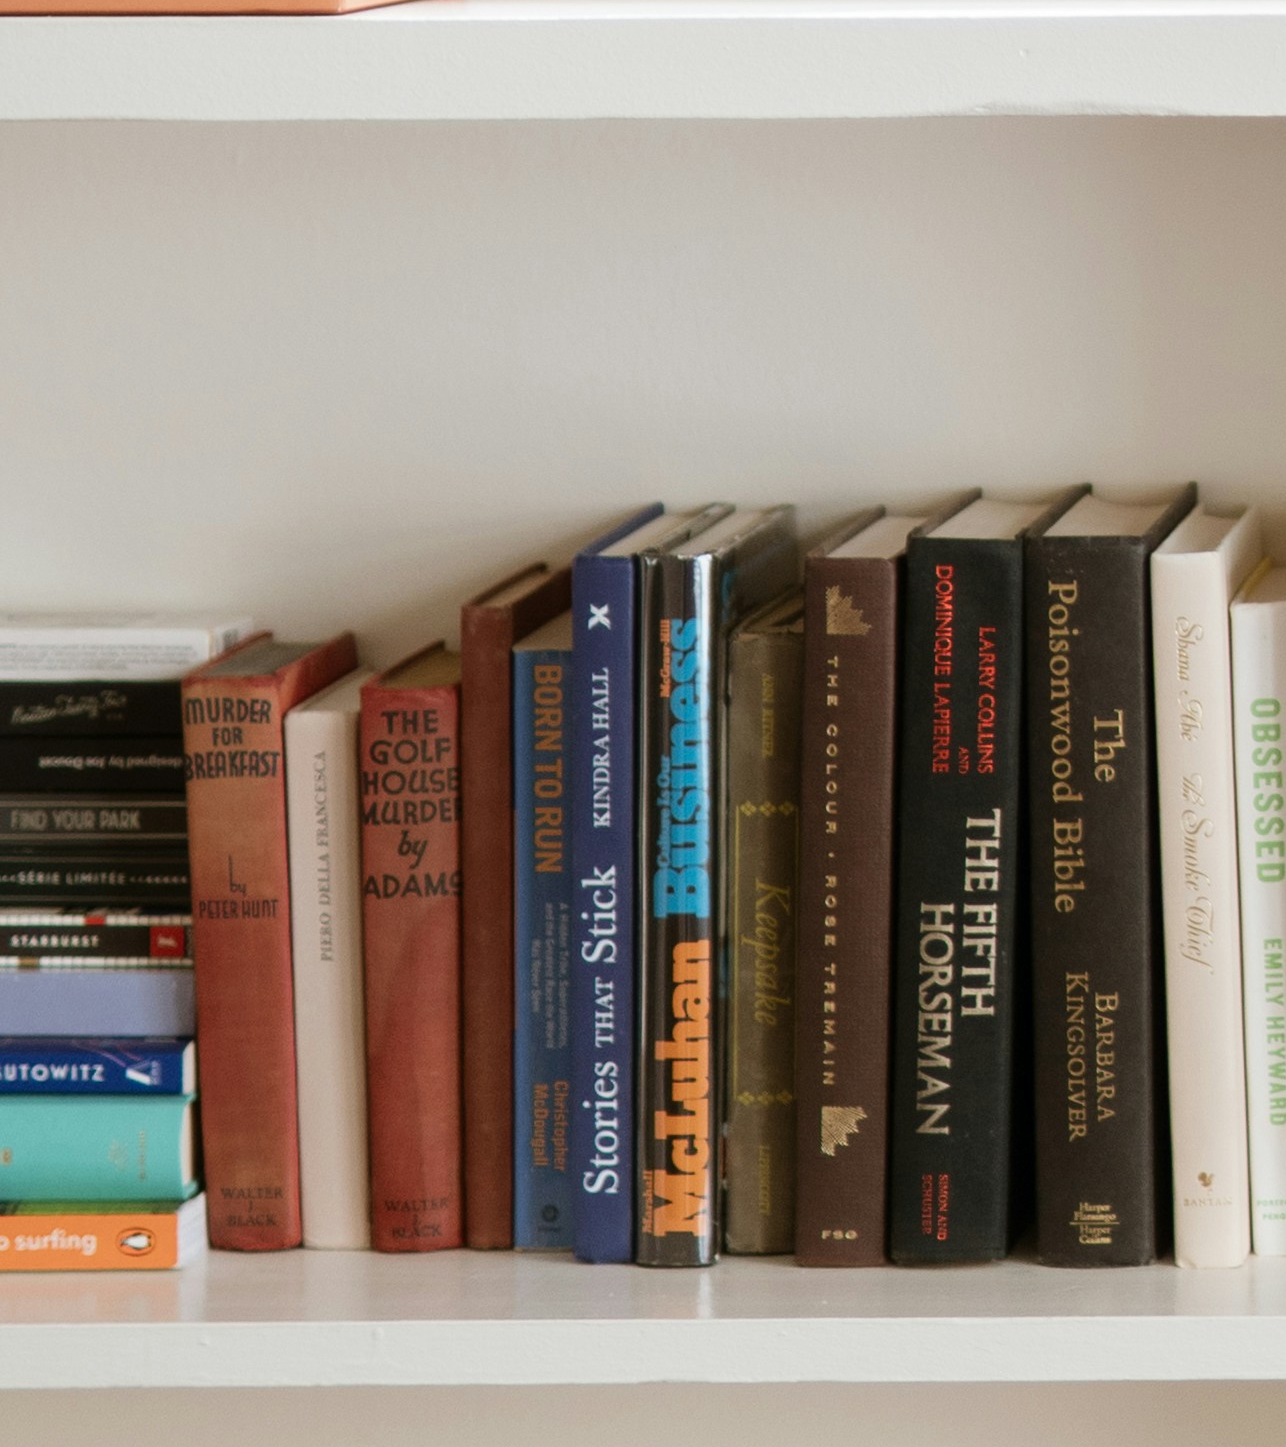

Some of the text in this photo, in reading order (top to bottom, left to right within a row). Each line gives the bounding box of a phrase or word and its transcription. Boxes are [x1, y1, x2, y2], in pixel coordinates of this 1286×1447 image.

[185, 698, 271, 724] MURDER
[534, 665, 562, 751] BORN
[932, 564, 954, 774] DOMINIQUE LAPIERRE
[976, 626, 996, 774] LARRY COLLINS
[213, 727, 243, 746] FOR
[370, 739, 450, 764] GOLF
[381, 710, 438, 734] THE
[592, 667, 610, 828] KINDRA HALL
[958, 746, 970, 775] AND
[1048, 579, 1086, 913] Poisonwood Bible
[1094, 708, 1128, 783] The
[534, 760, 562, 800] TO
[654, 618, 710, 918] Business
[1250, 698, 1286, 883] OBSESSED
[314, 751, 332, 961] PIERO DELLA FRANCESCA
[534, 808, 562, 873] RUN
[822, 656, 839, 1086] THE COLOUR ROSE TREMAIN
[11, 935, 99, 947] STARBURST
[741, 877, 790, 1025] Keepsake
[961, 808, 1001, 1017] THE FIFTH
[1264, 938, 1285, 1007] EMILY
[581, 865, 619, 1195] Stories THAT Stick
[916, 901, 955, 1136] HORSEMAN
[1065, 971, 1090, 1143] KINGSOLVER
[1095, 991, 1119, 1122] BARBARA
[533, 1083, 548, 1167] McDougall
[553, 1080, 569, 1171] Christopher
[221, 1187, 284, 1199] WALTER
[226, 1215, 277, 1227] BLACK
[384, 1199, 447, 1211] WALTER
[15, 1228, 97, 1255] surfing
